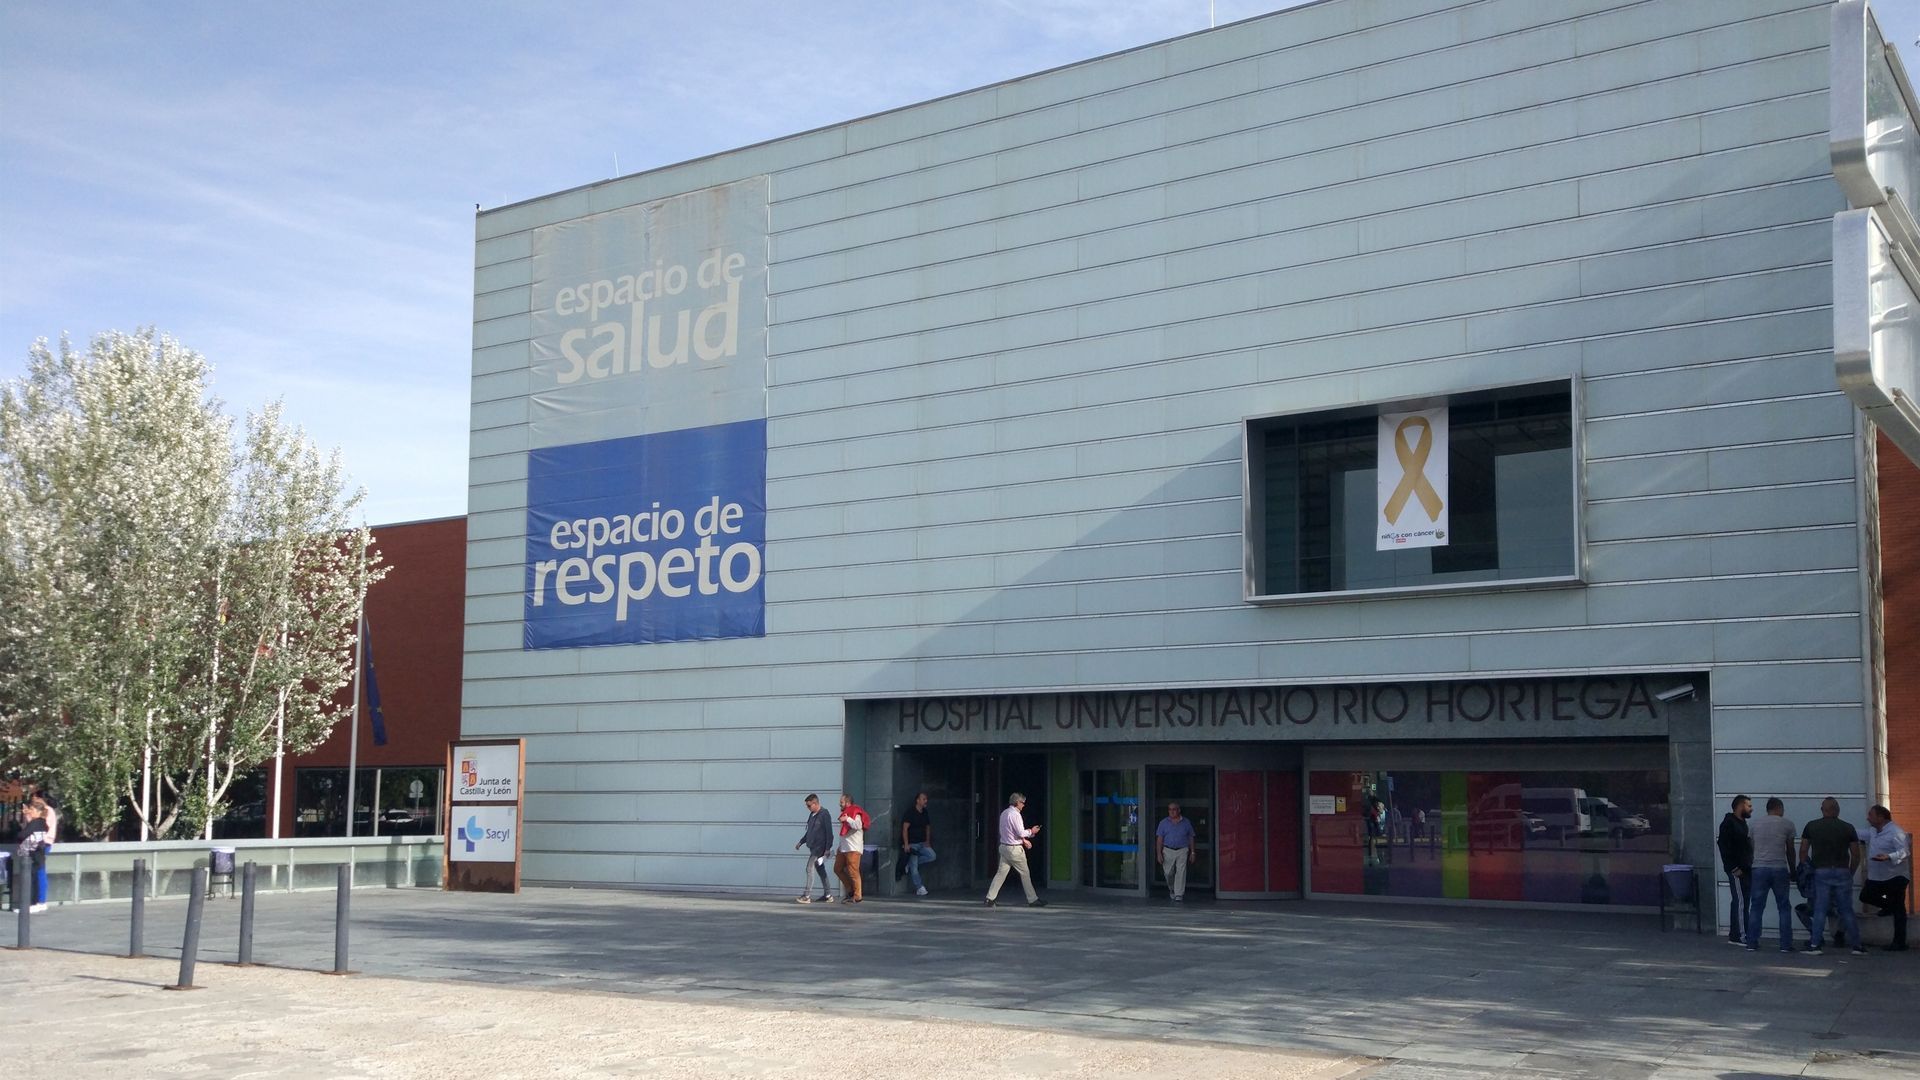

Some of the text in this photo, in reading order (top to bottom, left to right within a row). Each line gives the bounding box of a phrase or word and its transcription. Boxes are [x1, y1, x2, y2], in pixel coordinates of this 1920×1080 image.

[555, 248, 746, 321] espacio de
[557, 281, 741, 384] salud
[550, 496, 744, 558] espacio de
[533, 536, 762, 621] respeto
[898, 693, 1042, 732] HOSPITAL
[1055, 684, 1319, 730] UNIVERSITARIO
[1426, 677, 1659, 723] HORTEGA
[460, 786, 511, 797] Castilla y León
[502, 777, 511, 785] de
[486, 828, 510, 842] Sacyl
